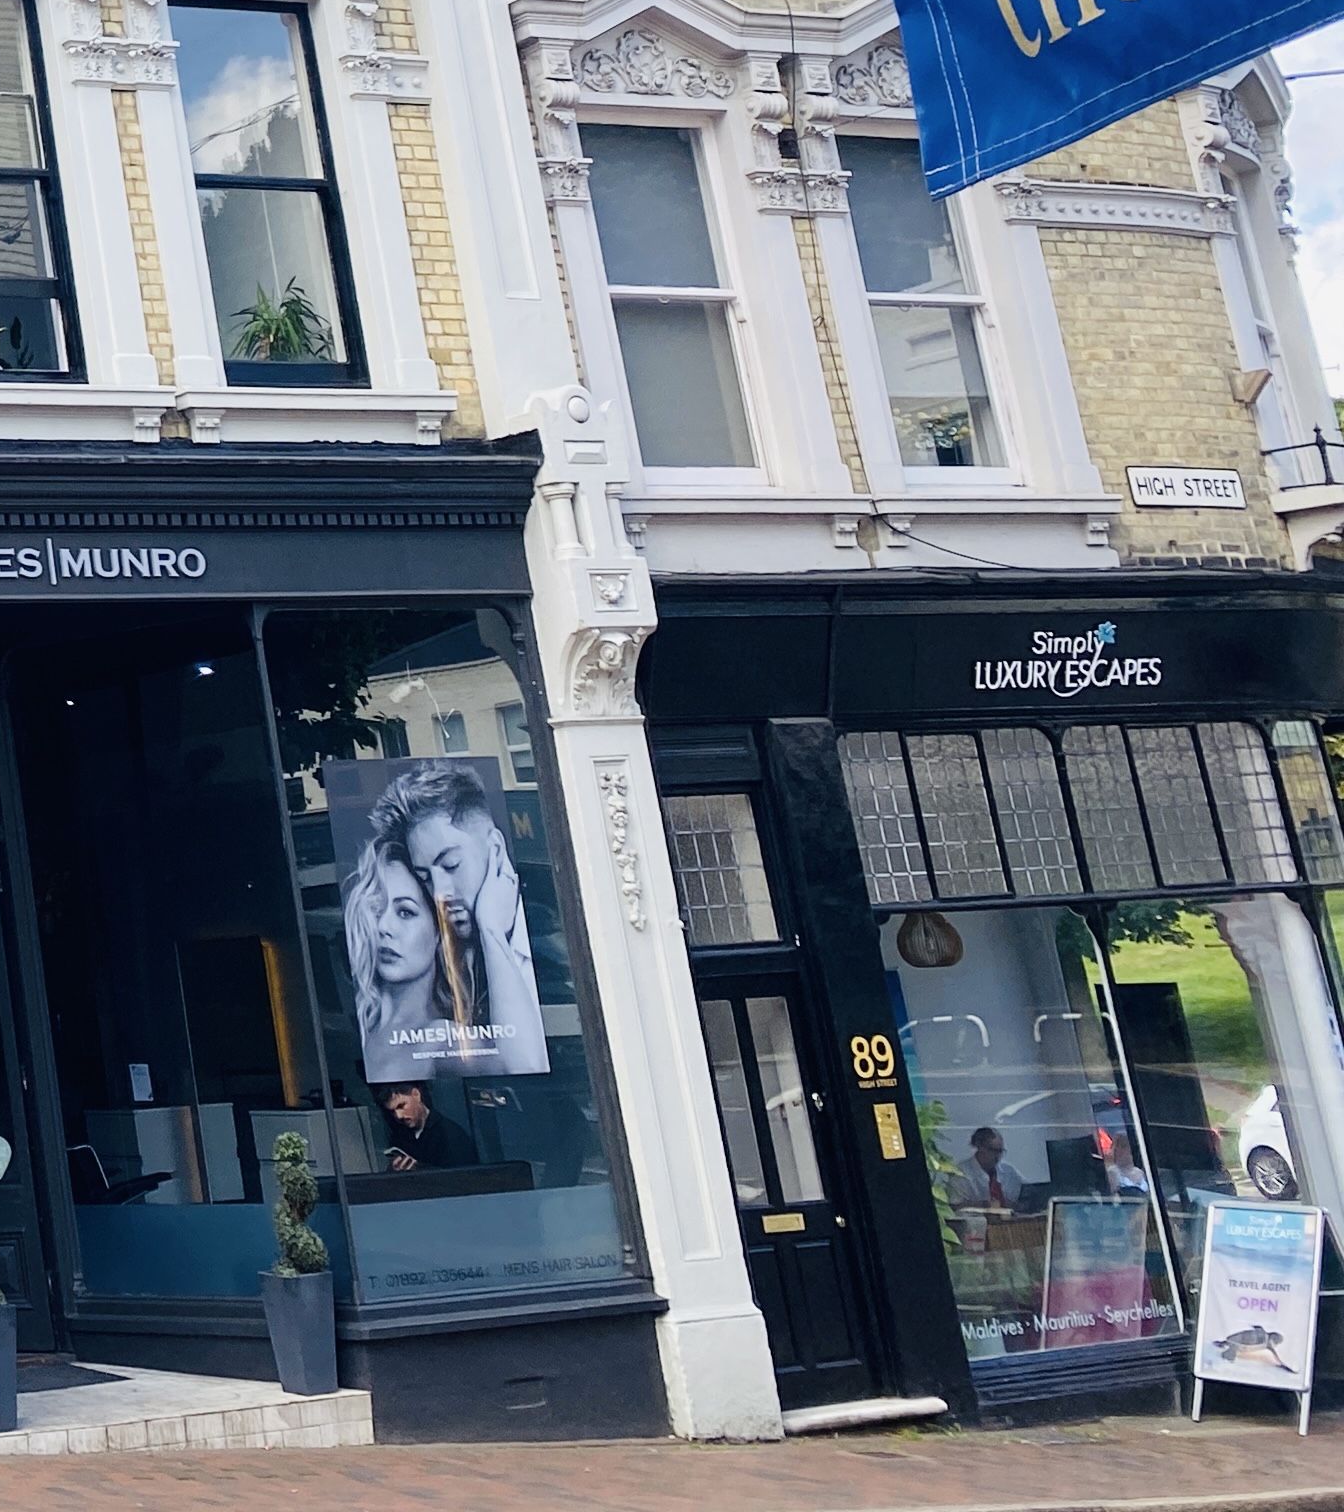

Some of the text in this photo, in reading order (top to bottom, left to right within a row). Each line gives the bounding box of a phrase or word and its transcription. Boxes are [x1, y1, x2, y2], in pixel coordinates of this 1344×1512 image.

[1135, 476, 1239, 499] HIGH STREET
[1031, 630, 1106, 660] Simply
[975, 657, 1163, 691] LUXURY ESCAPES
[850, 1033, 895, 1079] 89
[1225, 1224, 1302, 1241] LUXURY ESCAPES
[502, 1259, 540, 1276] MENS
[542, 1256, 573, 1272] HAIR
[575, 1252, 618, 1270] SALON
[1228, 1278, 1291, 1293] TRAVEL AGENT
[1237, 1296, 1279, 1313] OPEN
[960, 1298, 1176, 1340] Maldives Mauritius Seychelles
